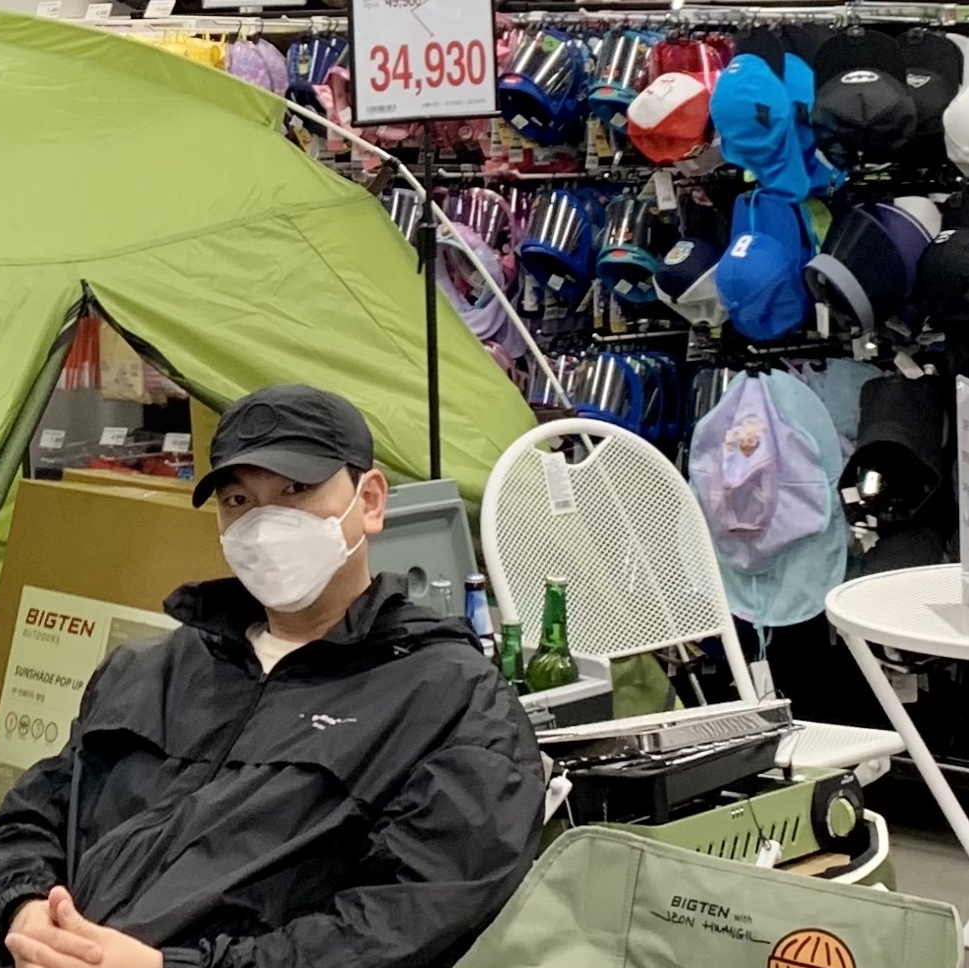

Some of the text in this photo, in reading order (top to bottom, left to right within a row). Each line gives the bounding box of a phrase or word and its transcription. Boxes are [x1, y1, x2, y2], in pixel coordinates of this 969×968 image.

[370, 39, 486, 96] 34,930
[25, 606, 96, 638] BIGTEN
[14, 664, 84, 691] SUNSHADE POP UP
[670, 895, 753, 925] BIGTEN with
